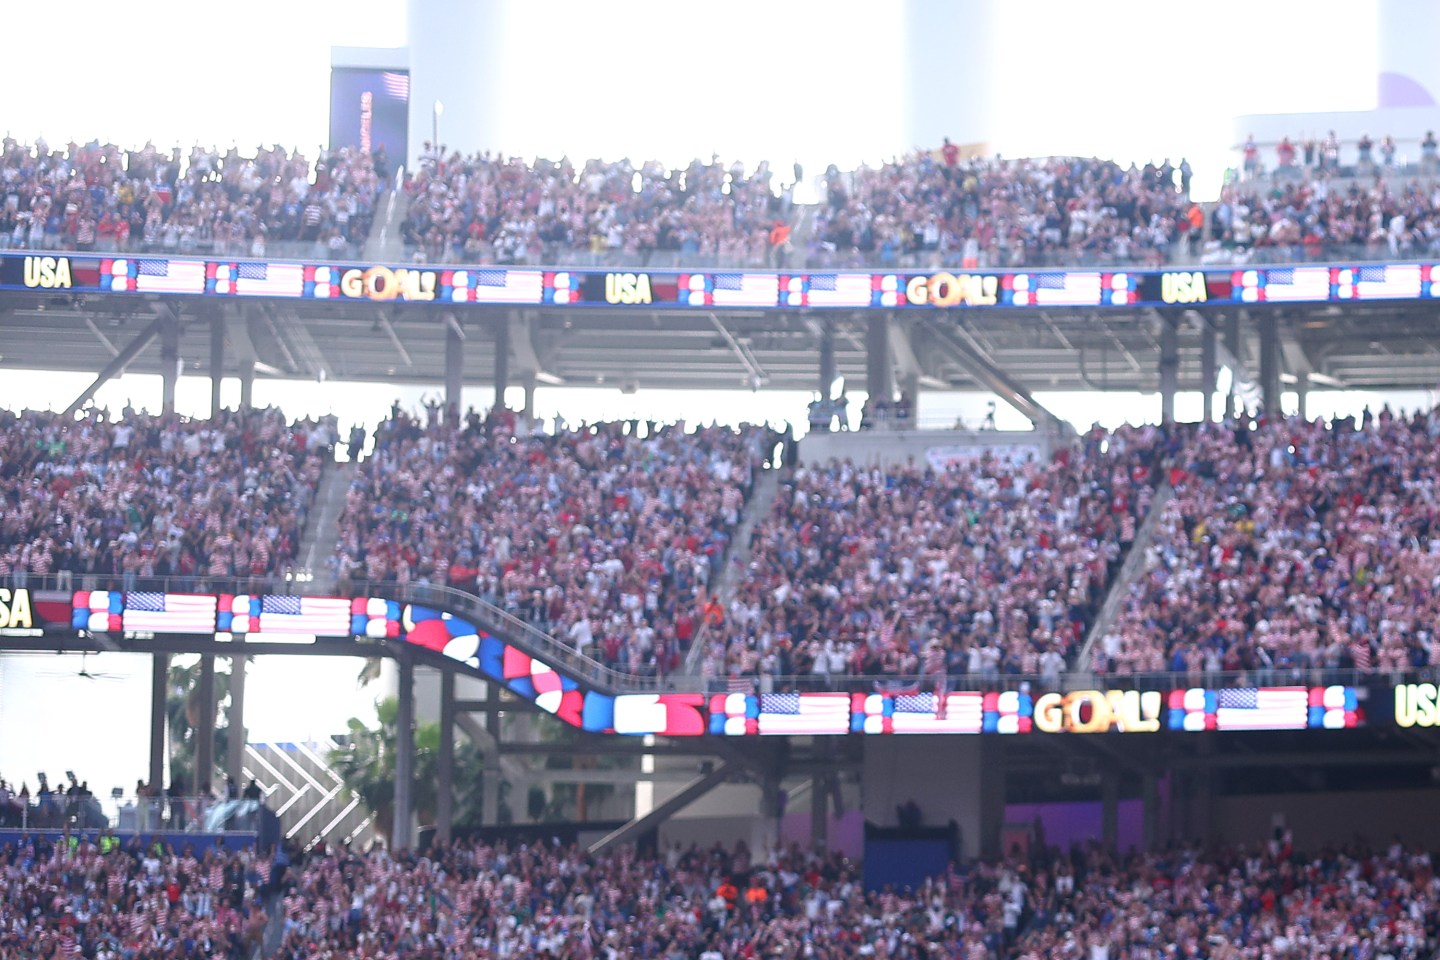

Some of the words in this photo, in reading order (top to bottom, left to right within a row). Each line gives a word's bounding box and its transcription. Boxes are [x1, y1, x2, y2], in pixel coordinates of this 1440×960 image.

[24, 257, 72, 289] USA
[341, 265, 436, 301] GOAL!
[605, 273, 652, 304] USA
[906, 271, 997, 308] GOAL!
[1161, 272, 1207, 303] USA
[0, 588, 32, 628] SA
[1034, 690, 1161, 733] GOAL!
